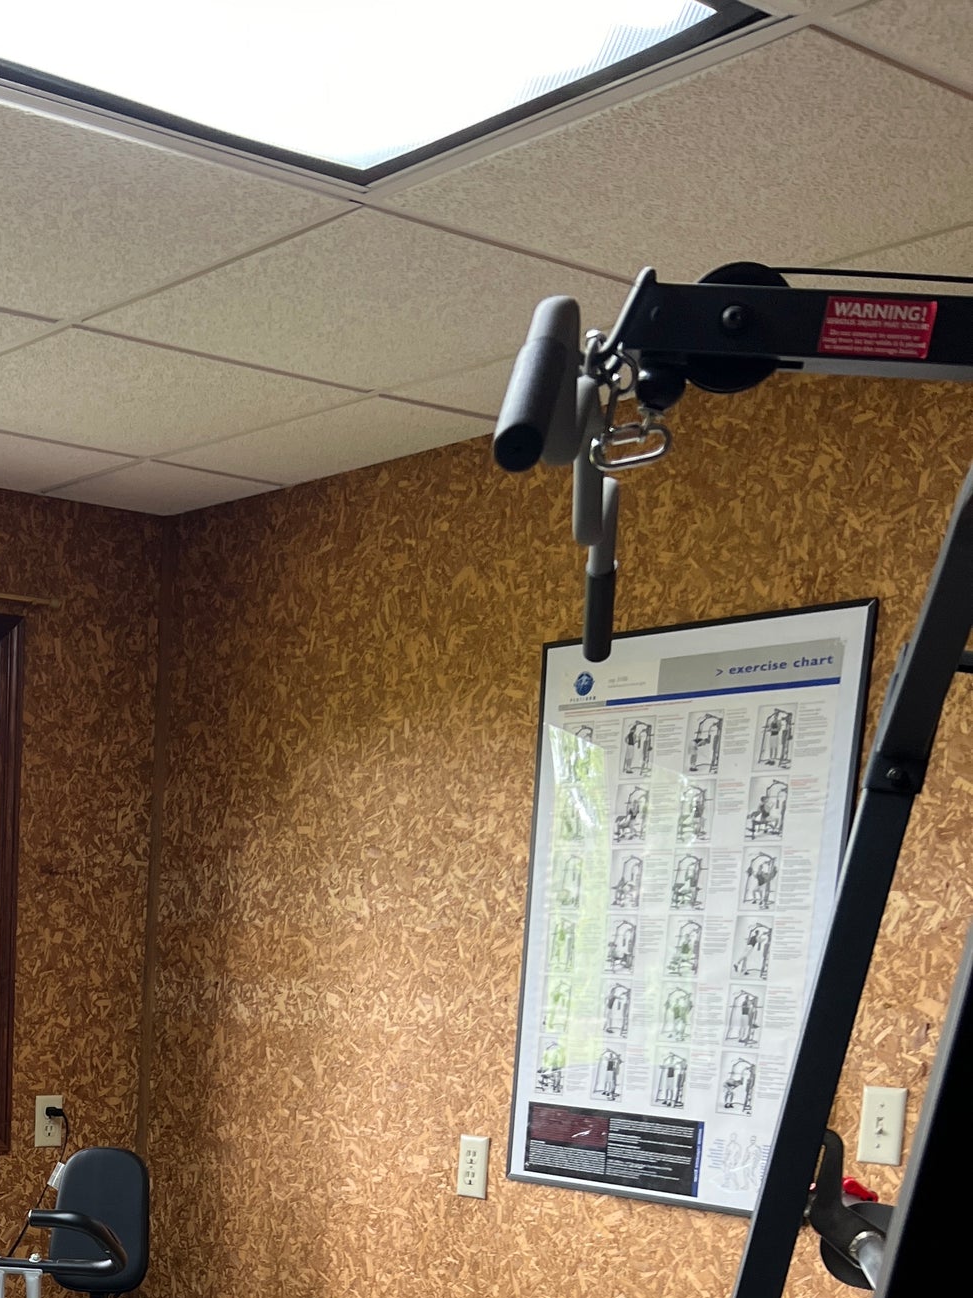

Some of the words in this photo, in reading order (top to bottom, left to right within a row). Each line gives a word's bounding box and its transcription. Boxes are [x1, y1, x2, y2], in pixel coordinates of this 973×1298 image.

[834, 302, 927, 322] WARNING!
[729, 659, 788, 676] exercise
[793, 655, 835, 669] chart
